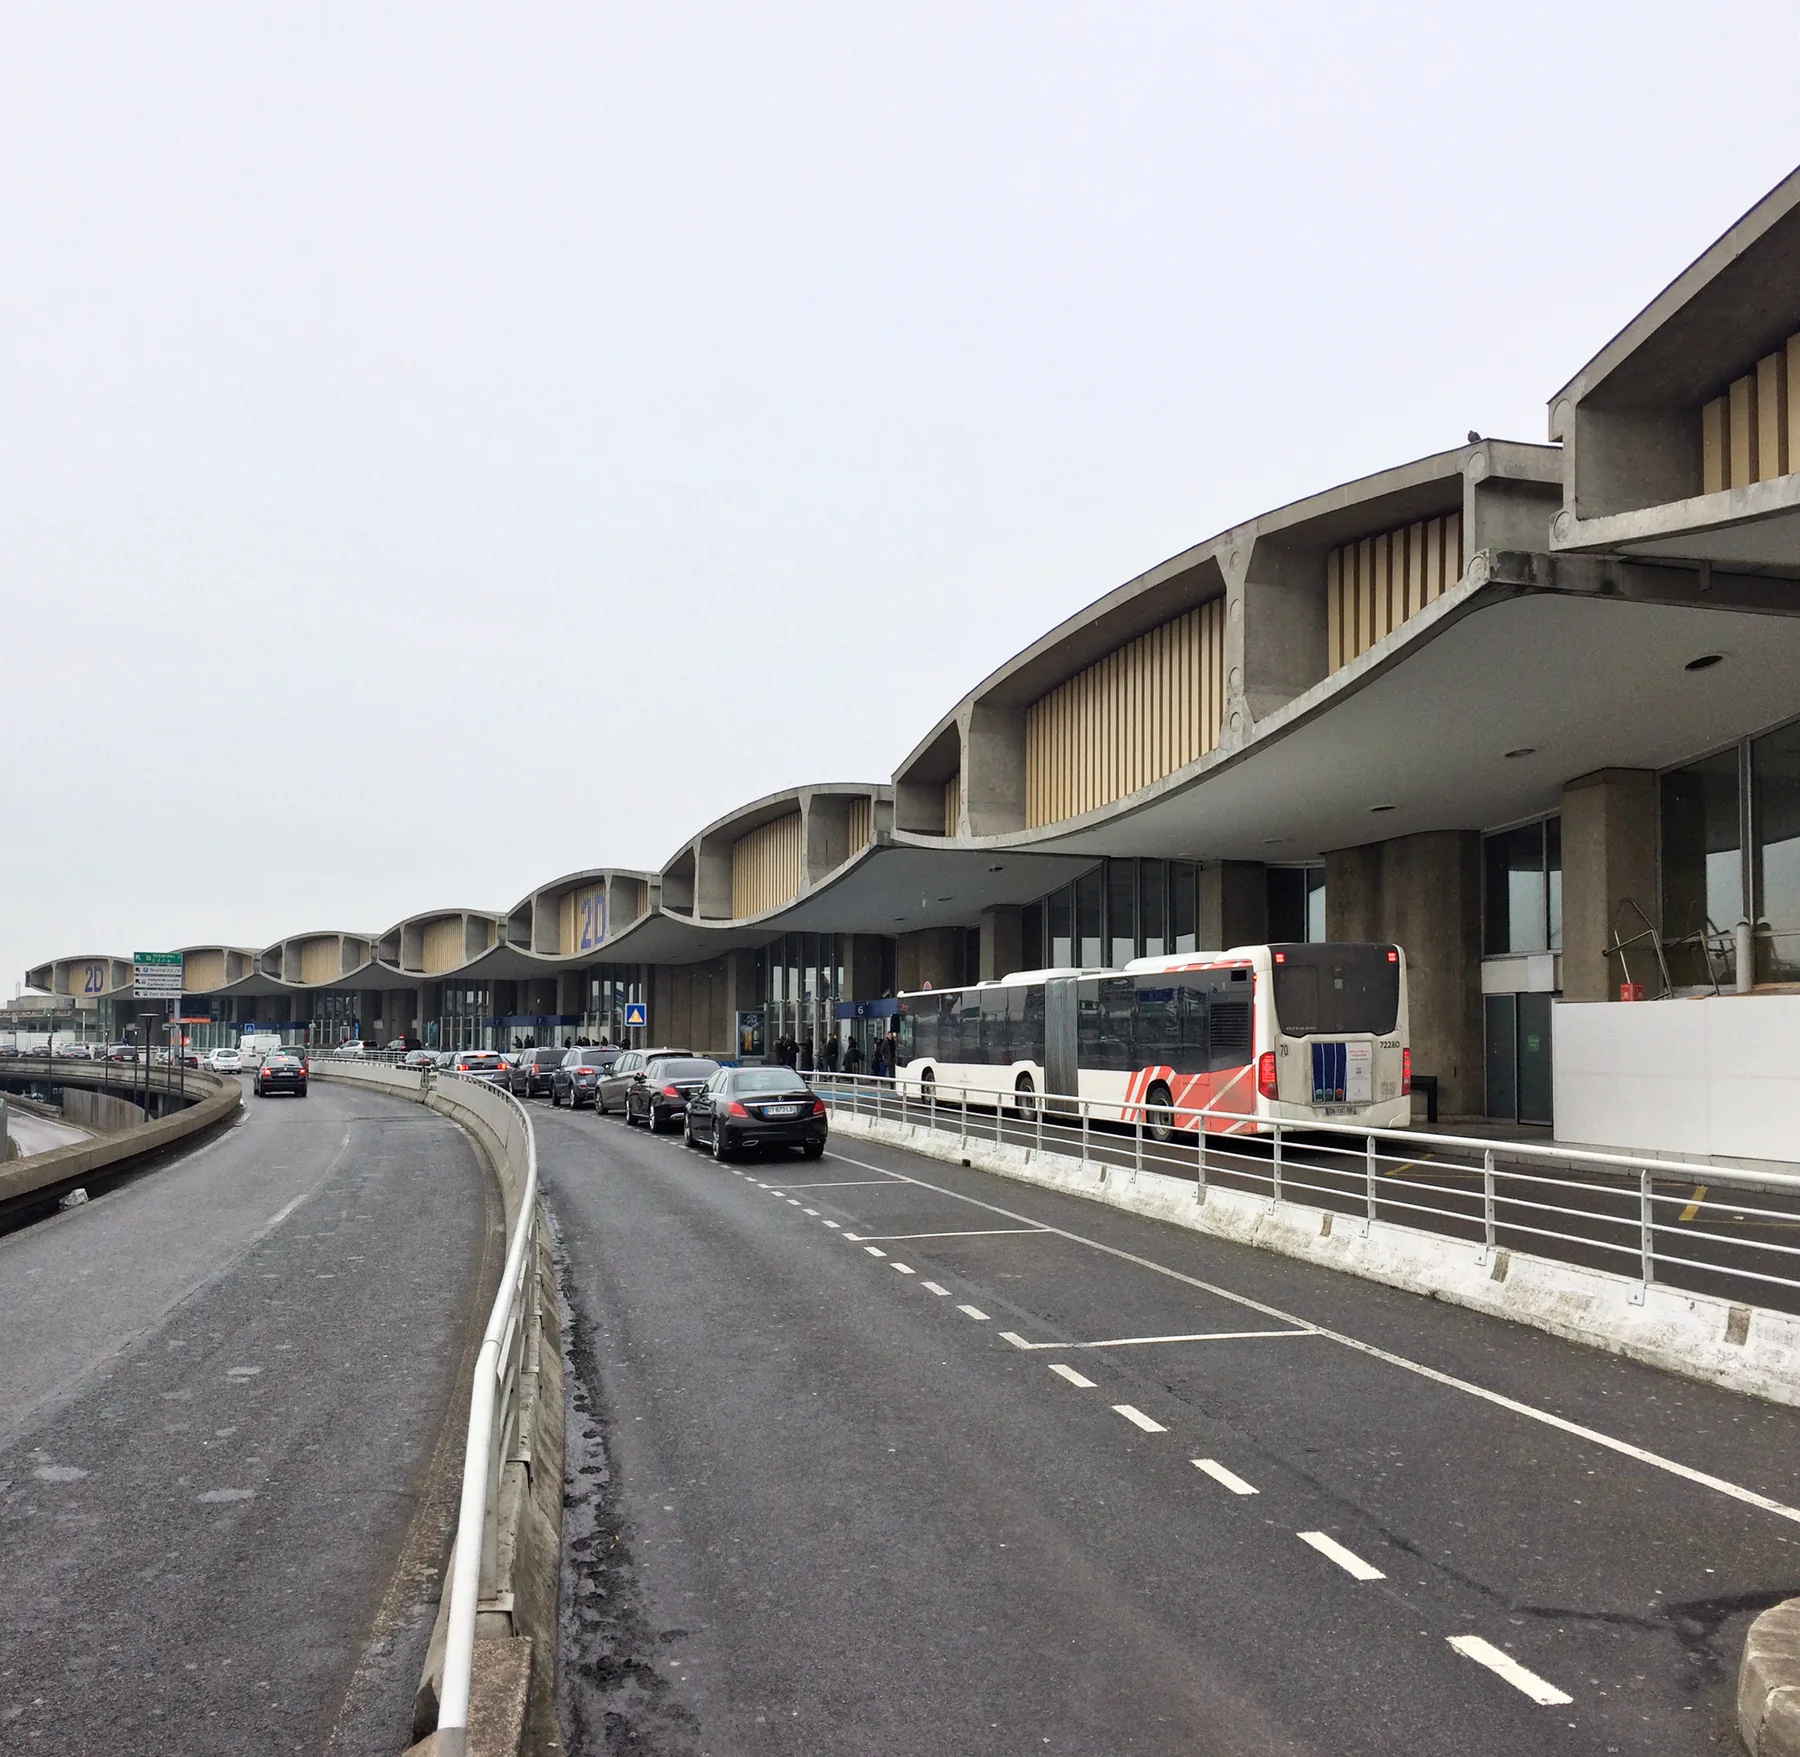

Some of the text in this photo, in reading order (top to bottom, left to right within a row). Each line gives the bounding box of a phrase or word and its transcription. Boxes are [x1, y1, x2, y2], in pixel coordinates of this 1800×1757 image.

[580, 895, 606, 949] 2D
[84, 966, 104, 992] 2D
[858, 1006, 864, 1014] 6
[1280, 1044, 1288, 1056] 70
[1379, 1040, 1400, 1049] 72280
